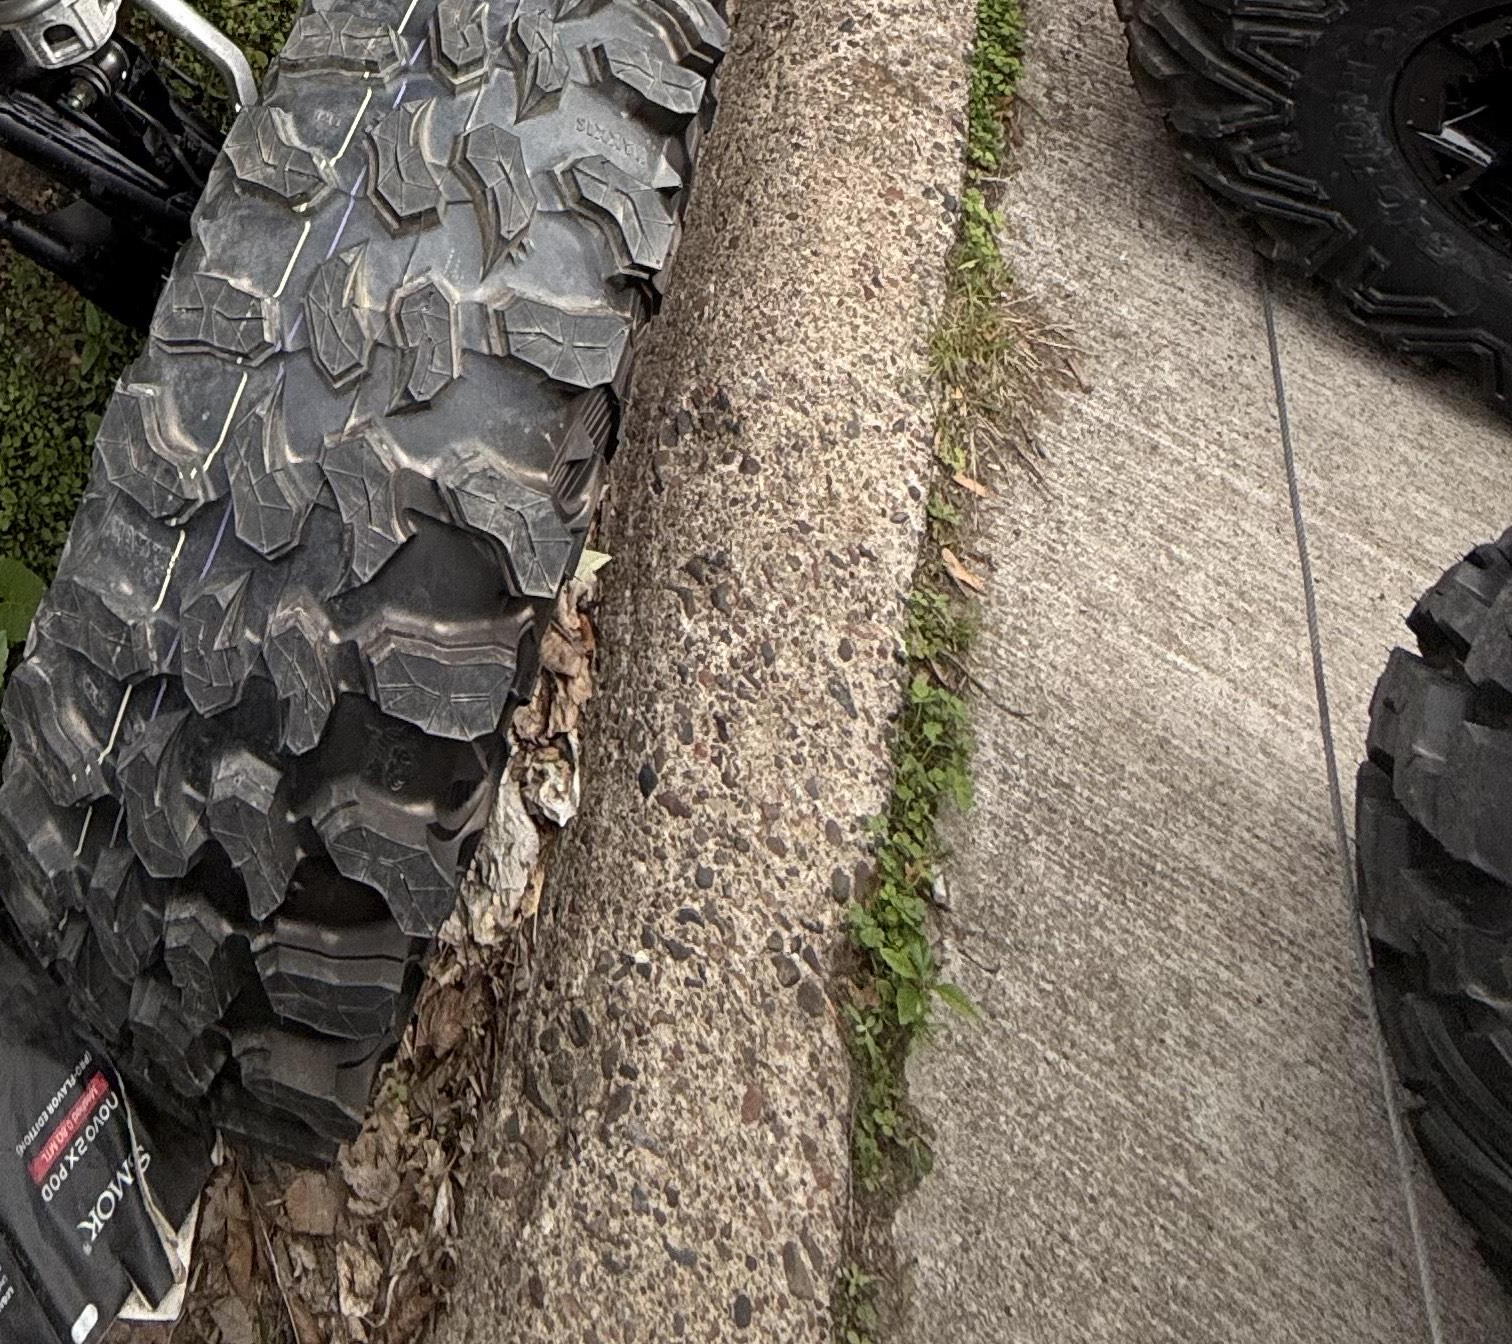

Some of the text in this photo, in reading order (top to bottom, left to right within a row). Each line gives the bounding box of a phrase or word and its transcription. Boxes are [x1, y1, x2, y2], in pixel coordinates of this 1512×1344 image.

[64, 1137, 88, 1171] 2X
[41, 1162, 68, 1202] POD
[77, 1144, 151, 1243] SMOK
